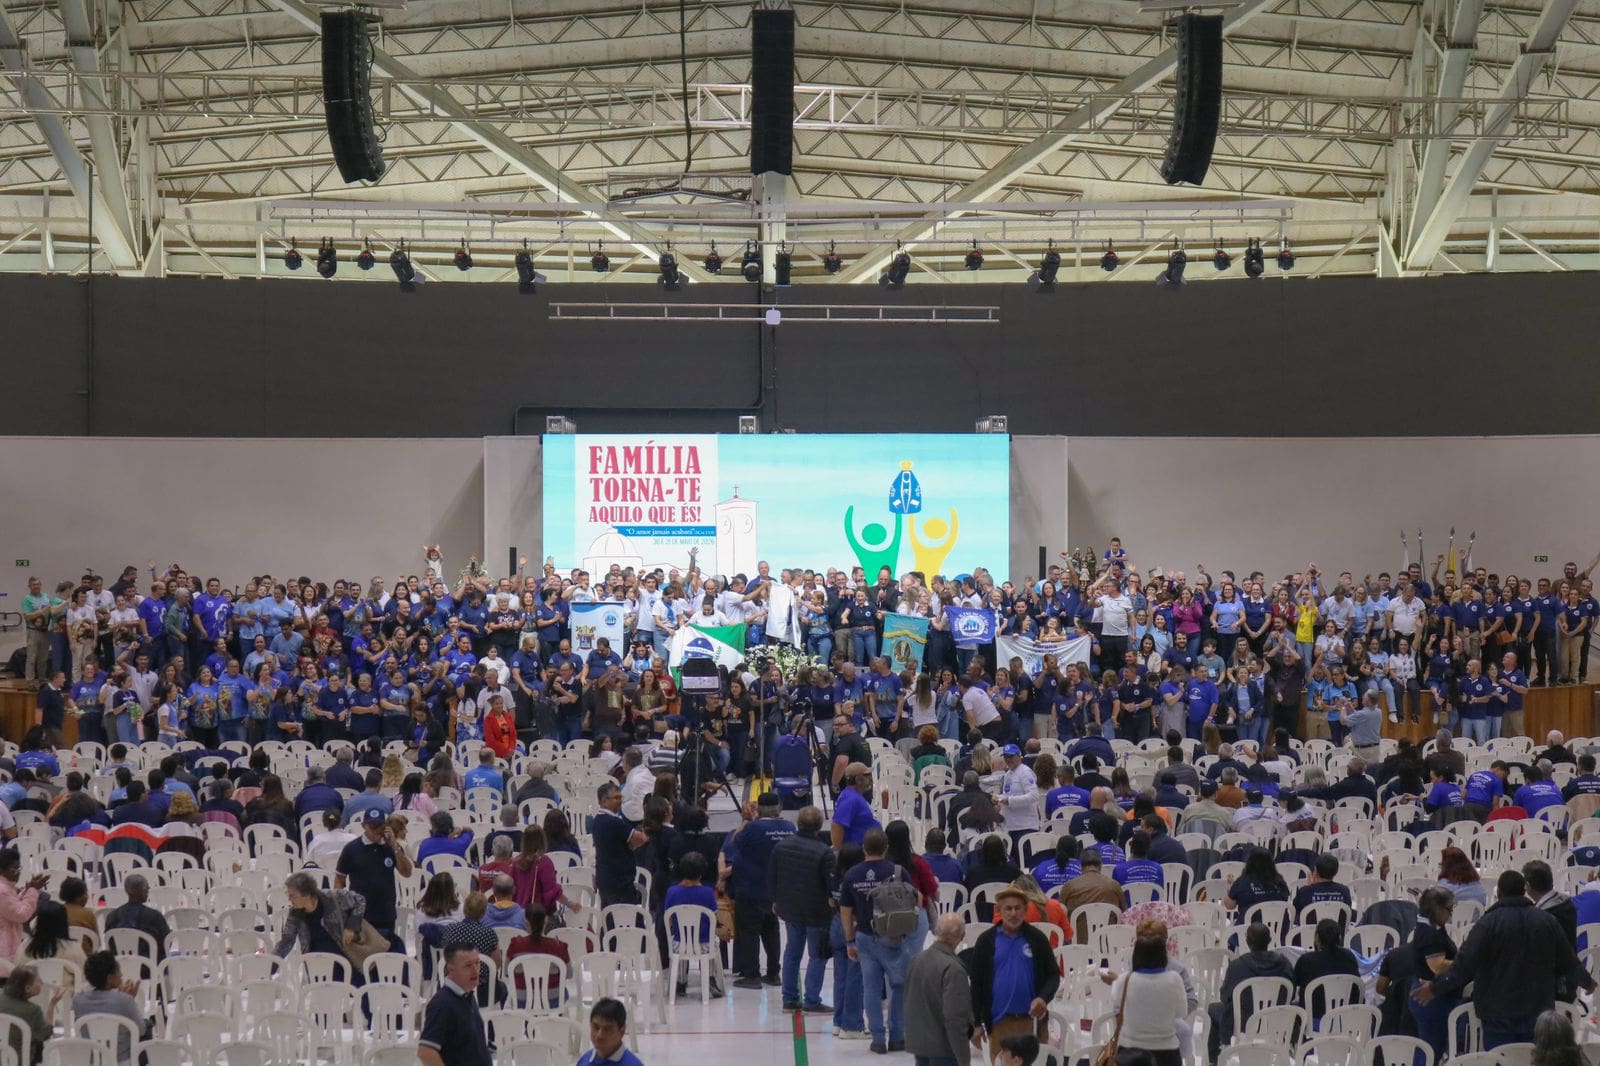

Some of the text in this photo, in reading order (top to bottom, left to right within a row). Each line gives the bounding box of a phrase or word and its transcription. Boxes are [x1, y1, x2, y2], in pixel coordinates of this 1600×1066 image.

[589, 440, 702, 475] FAMÍLIA
[589, 477, 701, 502] TORNA-TE
[589, 502, 702, 524] AQUILO QUE ÉS!
[652, 528, 670, 536] jamais
